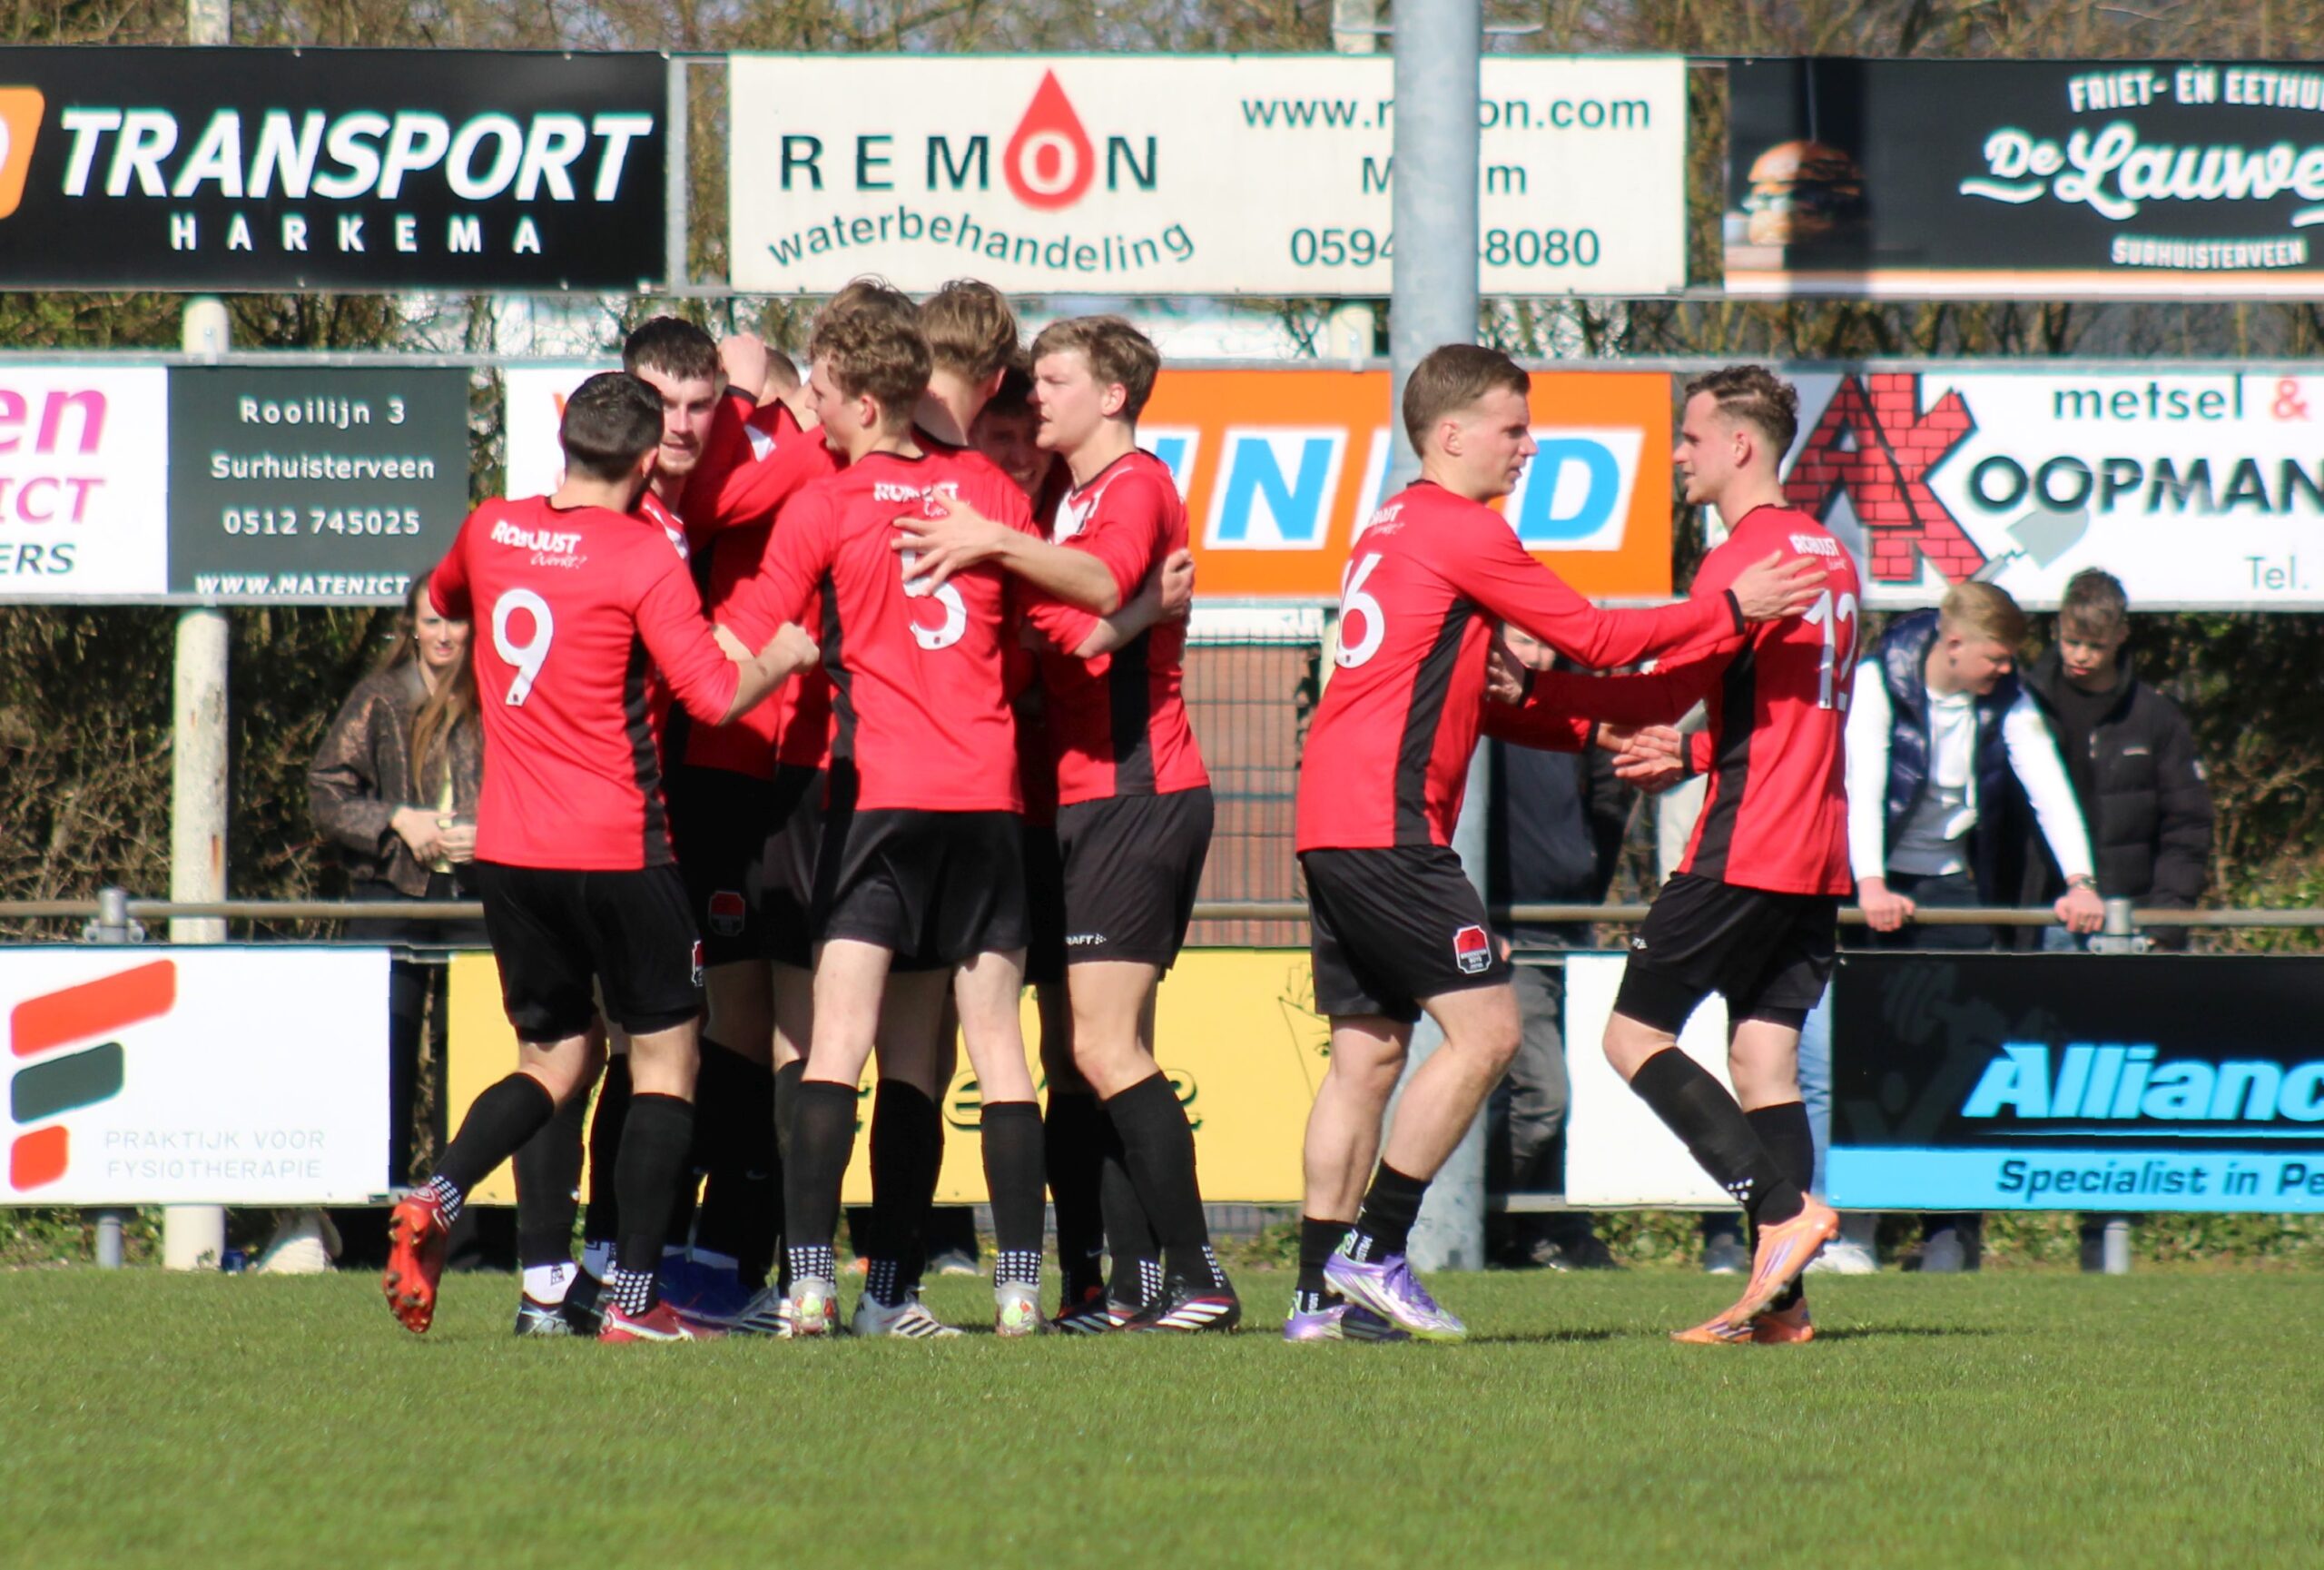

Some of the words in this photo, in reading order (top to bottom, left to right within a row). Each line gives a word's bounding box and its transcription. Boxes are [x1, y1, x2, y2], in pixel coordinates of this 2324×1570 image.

[60, 109, 654, 202] TRANSPORT
[781, 131, 1157, 194] REMON
[1984, 127, 2064, 178] De
[170, 213, 541, 254] HARKEMA
[768, 206, 1195, 272] waterbehandeling
[2111, 234, 2308, 269] SURHUISTERVEEN
[240, 396, 370, 430] Rooilijn
[387, 396, 405, 424] 3
[2054, 373, 2244, 420] metsel
[2271, 379, 2311, 420] &
[211, 452, 435, 479] Surhuisterveen
[222, 509, 298, 535] 0512
[309, 509, 419, 535] 745025
[901, 531, 967, 650] 5
[2245, 555, 2309, 590] Tel.
[492, 588, 554, 706] 9
[105, 1131, 241, 1150] PRAKTIJK
[254, 1131, 325, 1150] VOOR
[108, 1160, 321, 1180] FYSIOTHERAPIE
[1998, 1160, 2208, 1202] Specialist
[2221, 1162, 2260, 1195] in
